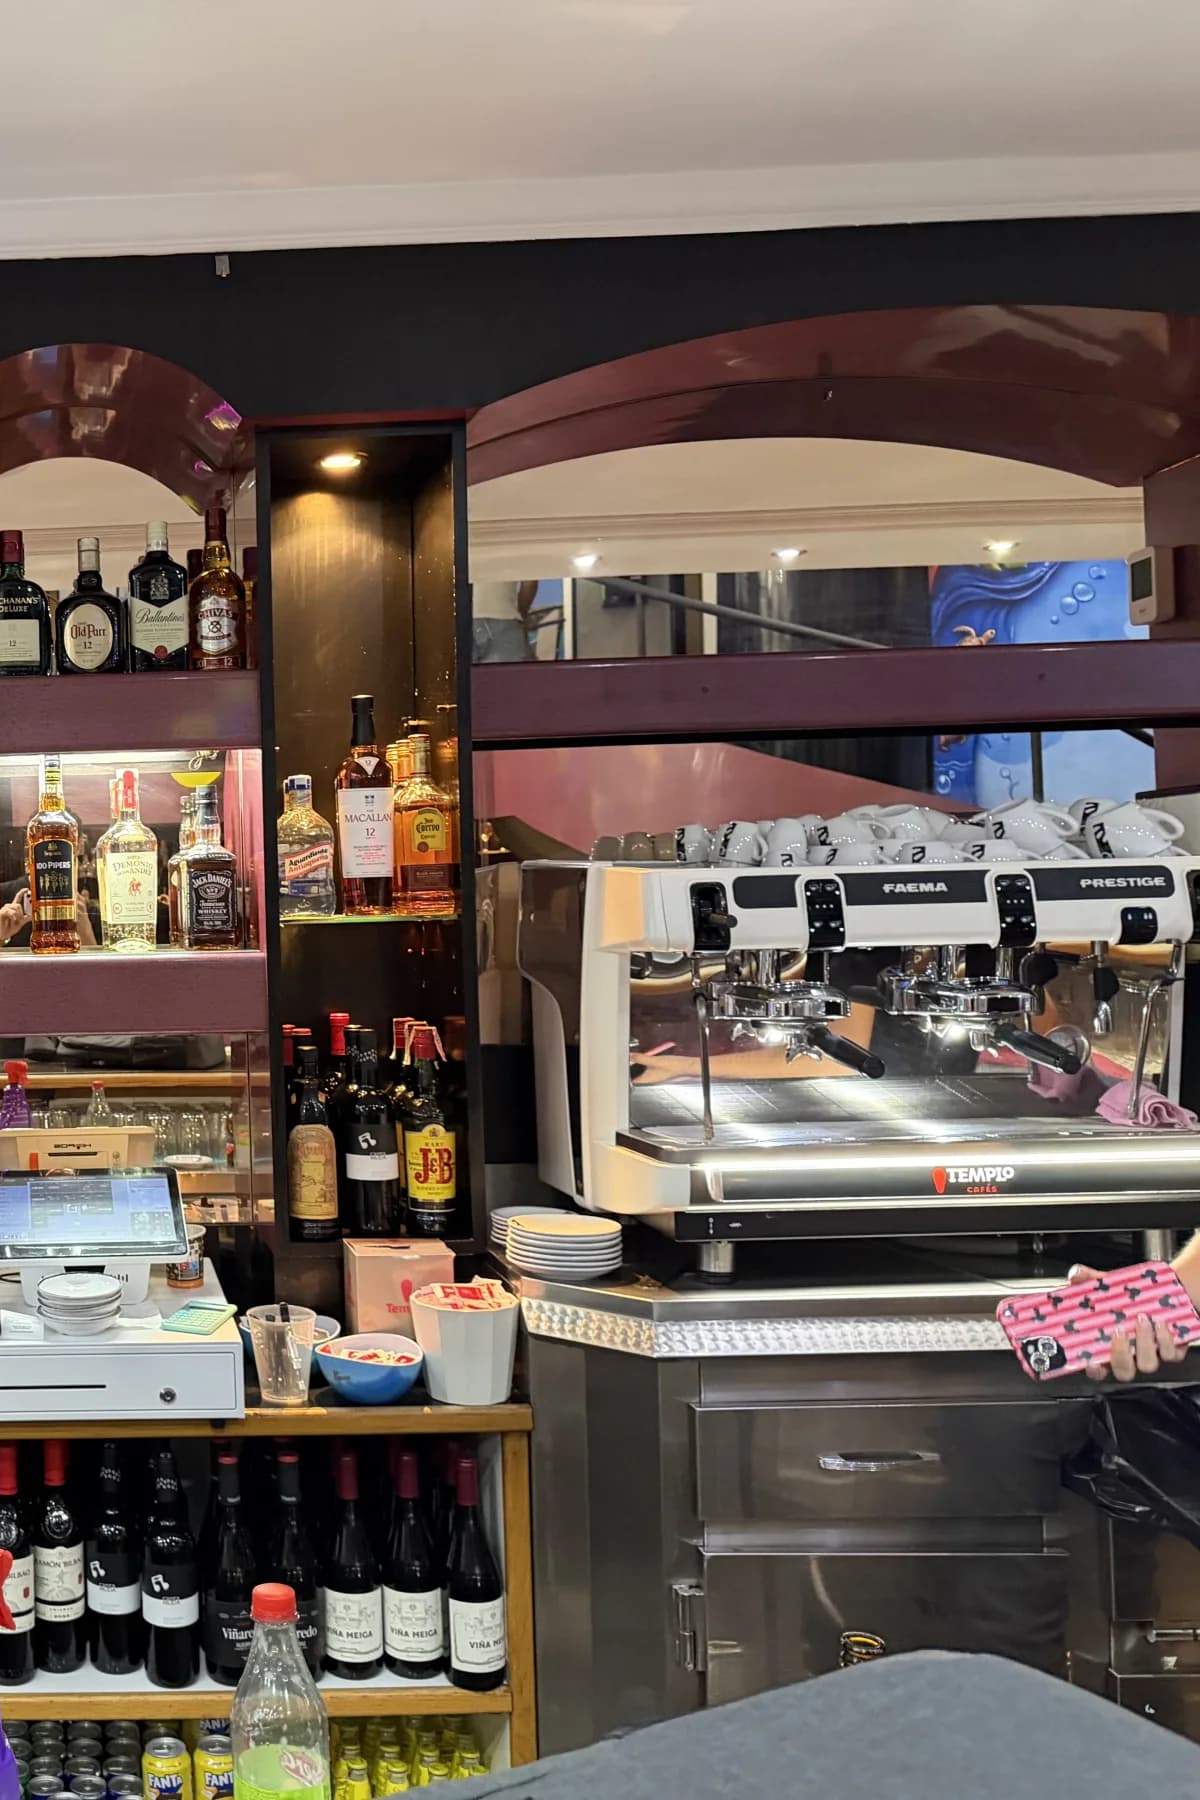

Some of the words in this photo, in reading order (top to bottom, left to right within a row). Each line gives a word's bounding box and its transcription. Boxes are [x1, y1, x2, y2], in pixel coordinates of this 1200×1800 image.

[198, 609, 233, 619] CHIVAS
[83, 641, 93, 649] 12
[344, 813, 393, 823] MACALLAN
[365, 828, 376, 837] 12
[192, 876, 207, 888] JACK
[882, 881, 948, 894] FAEMA
[1079, 876, 1166, 889] PRESTIGE
[414, 1147, 454, 1185] J&B
[946, 1166, 1014, 1184] TEMPLO
[386, 1303, 411, 1314] Tem
[8, 1569, 31, 1579] ILBAO
[222, 1627, 254, 1640] Viñar
[296, 1625, 318, 1639] redo
[468, 1639, 491, 1649] VIÑA
[200, 1719, 228, 1731] FANT
[148, 1774, 183, 1789] FANTA
[205, 1771, 233, 1788] FANT
